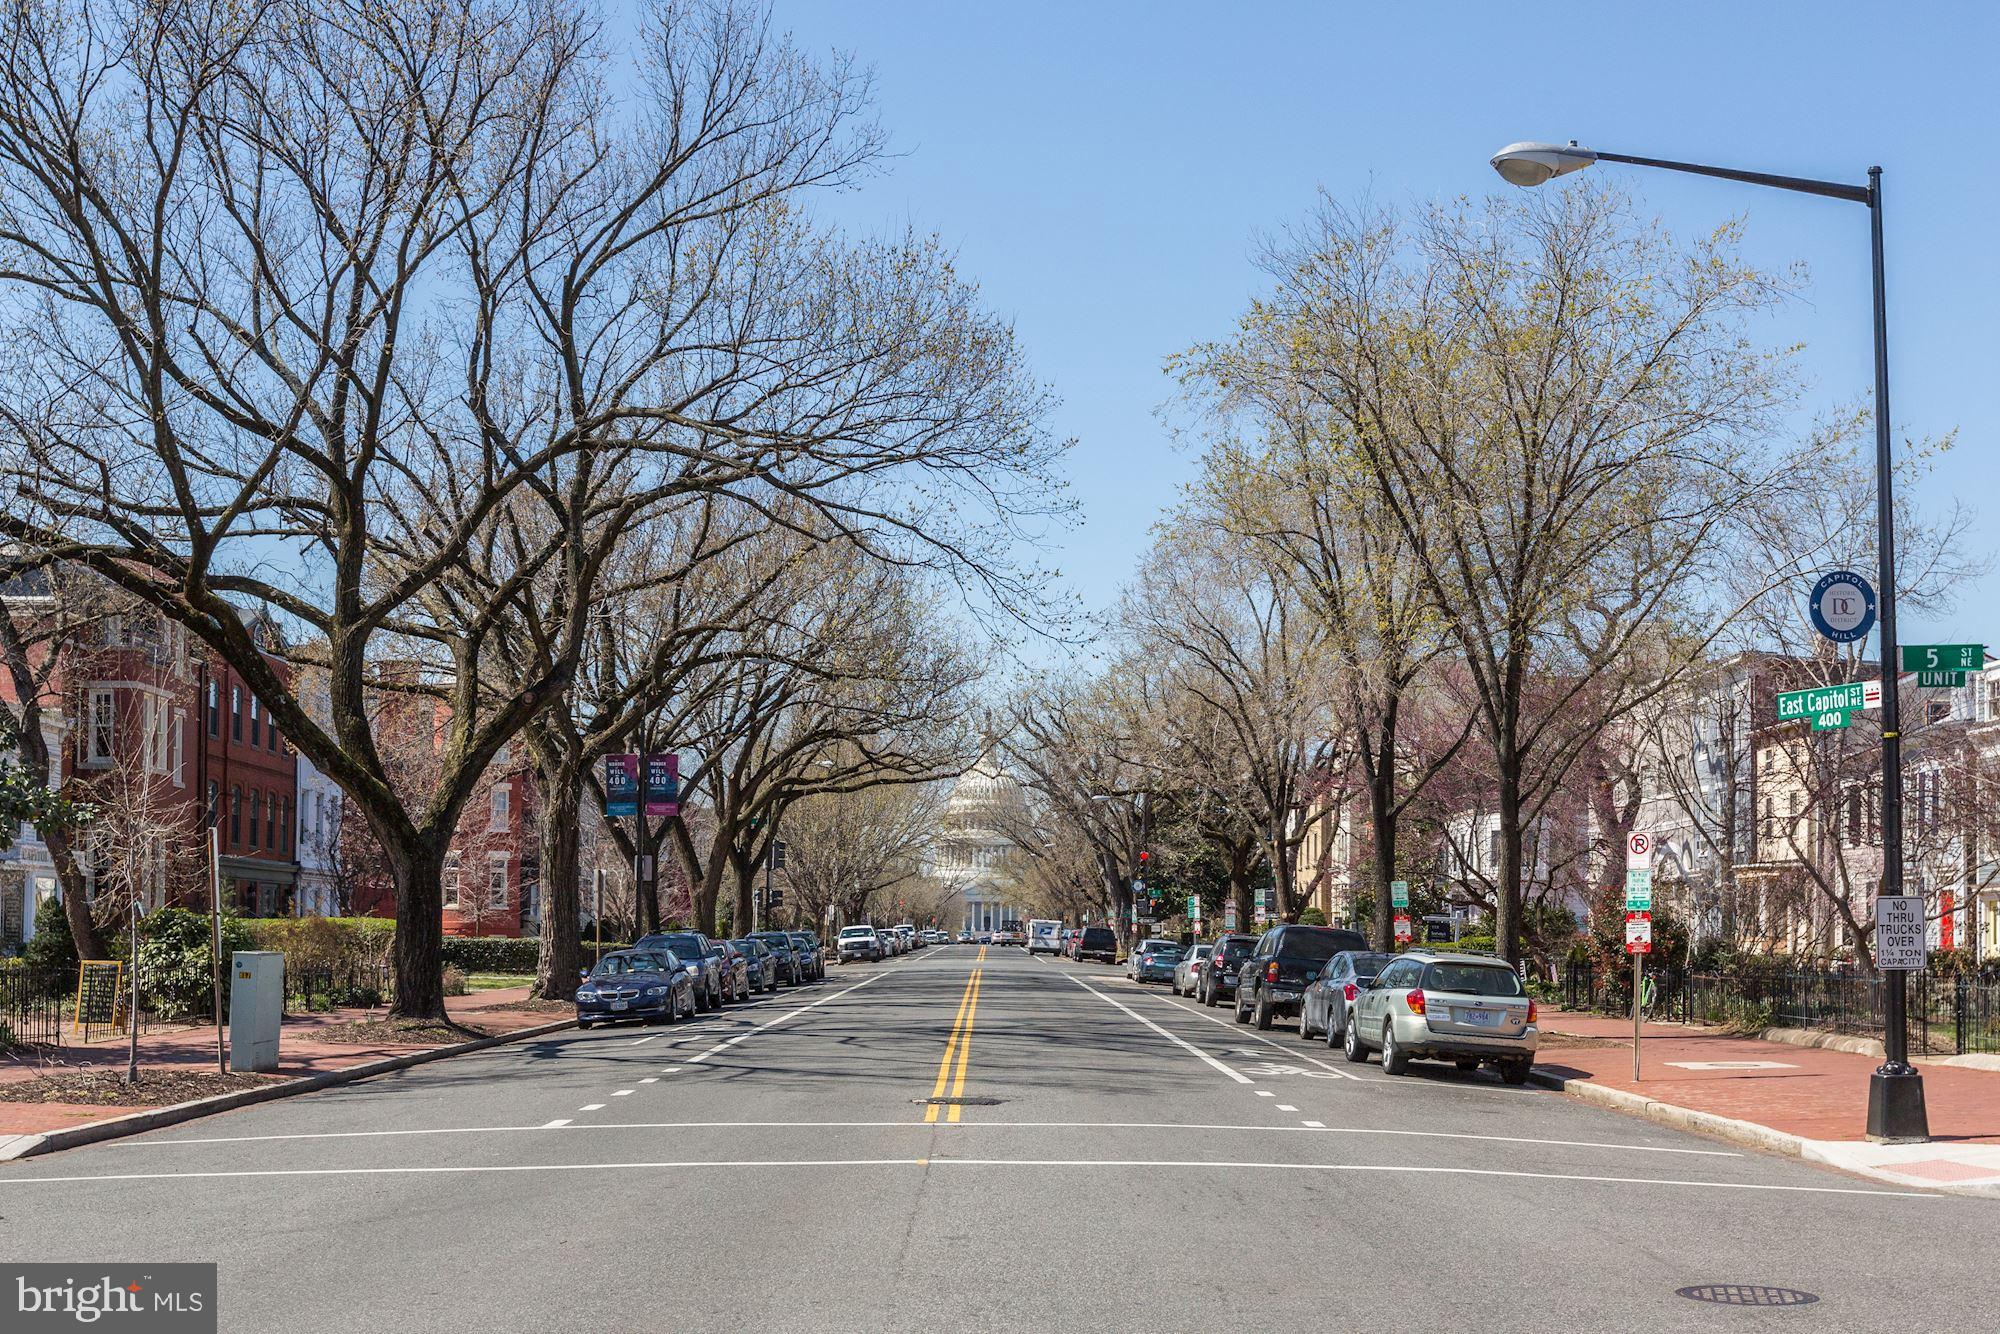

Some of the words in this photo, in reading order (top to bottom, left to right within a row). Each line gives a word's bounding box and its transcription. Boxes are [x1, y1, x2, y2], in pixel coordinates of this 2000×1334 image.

[1820, 574, 1864, 588] CAPITOL
[1832, 597, 1856, 615] DC
[1832, 631, 1857, 640] HILL
[1960, 647, 1973, 657] ST
[1926, 648, 1939, 669] 5
[1960, 657, 1973, 667] NE
[1922, 672, 1958, 686] UNIT
[1850, 687, 1861, 697] ST
[1779, 693, 1804, 717] East
[1807, 688, 1849, 714] Capitol
[1850, 697, 1862, 706] NE
[1818, 712, 1842, 728] 400
[609, 777, 626, 785] 400
[649, 776, 666, 784] 400
[1893, 900, 1907, 910] NO
[1887, 912, 1914, 922] THRU
[1879, 924, 1921, 935] TRUCKS
[1887, 936, 1914, 947] OVER
[1899, 949, 1921, 957] TON
[1880, 958, 1921, 966] CAPACITY
